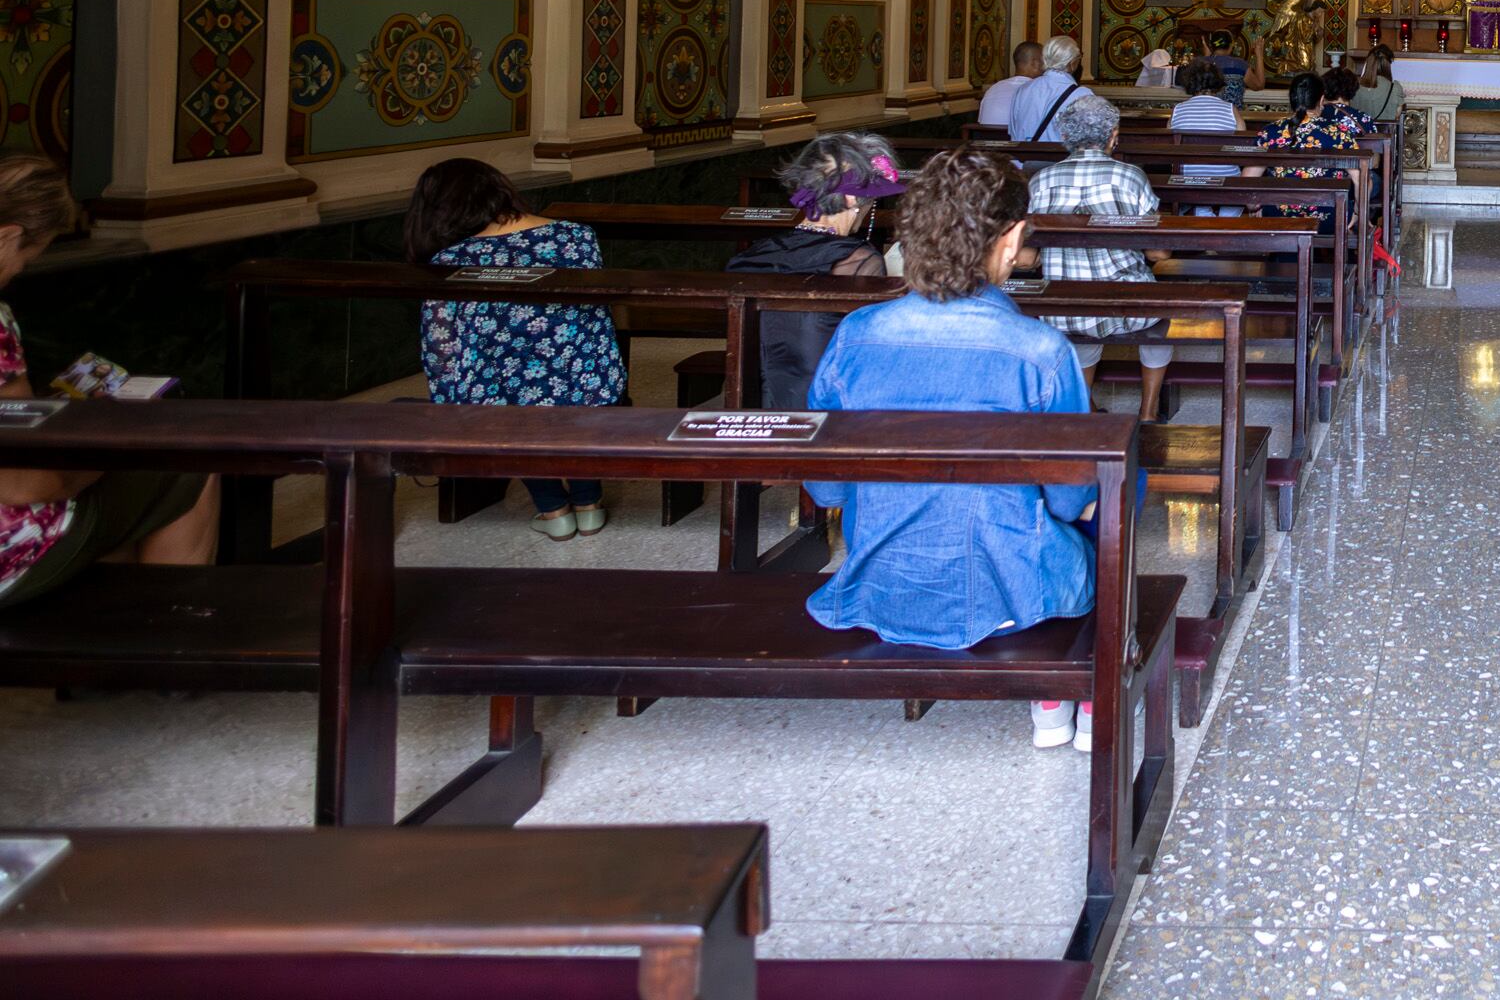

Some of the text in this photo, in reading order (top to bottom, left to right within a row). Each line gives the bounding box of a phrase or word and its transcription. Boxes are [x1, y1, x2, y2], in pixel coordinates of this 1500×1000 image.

[717, 415, 790, 423] POR FAVOR
[715, 429, 773, 437] GRACIAS
